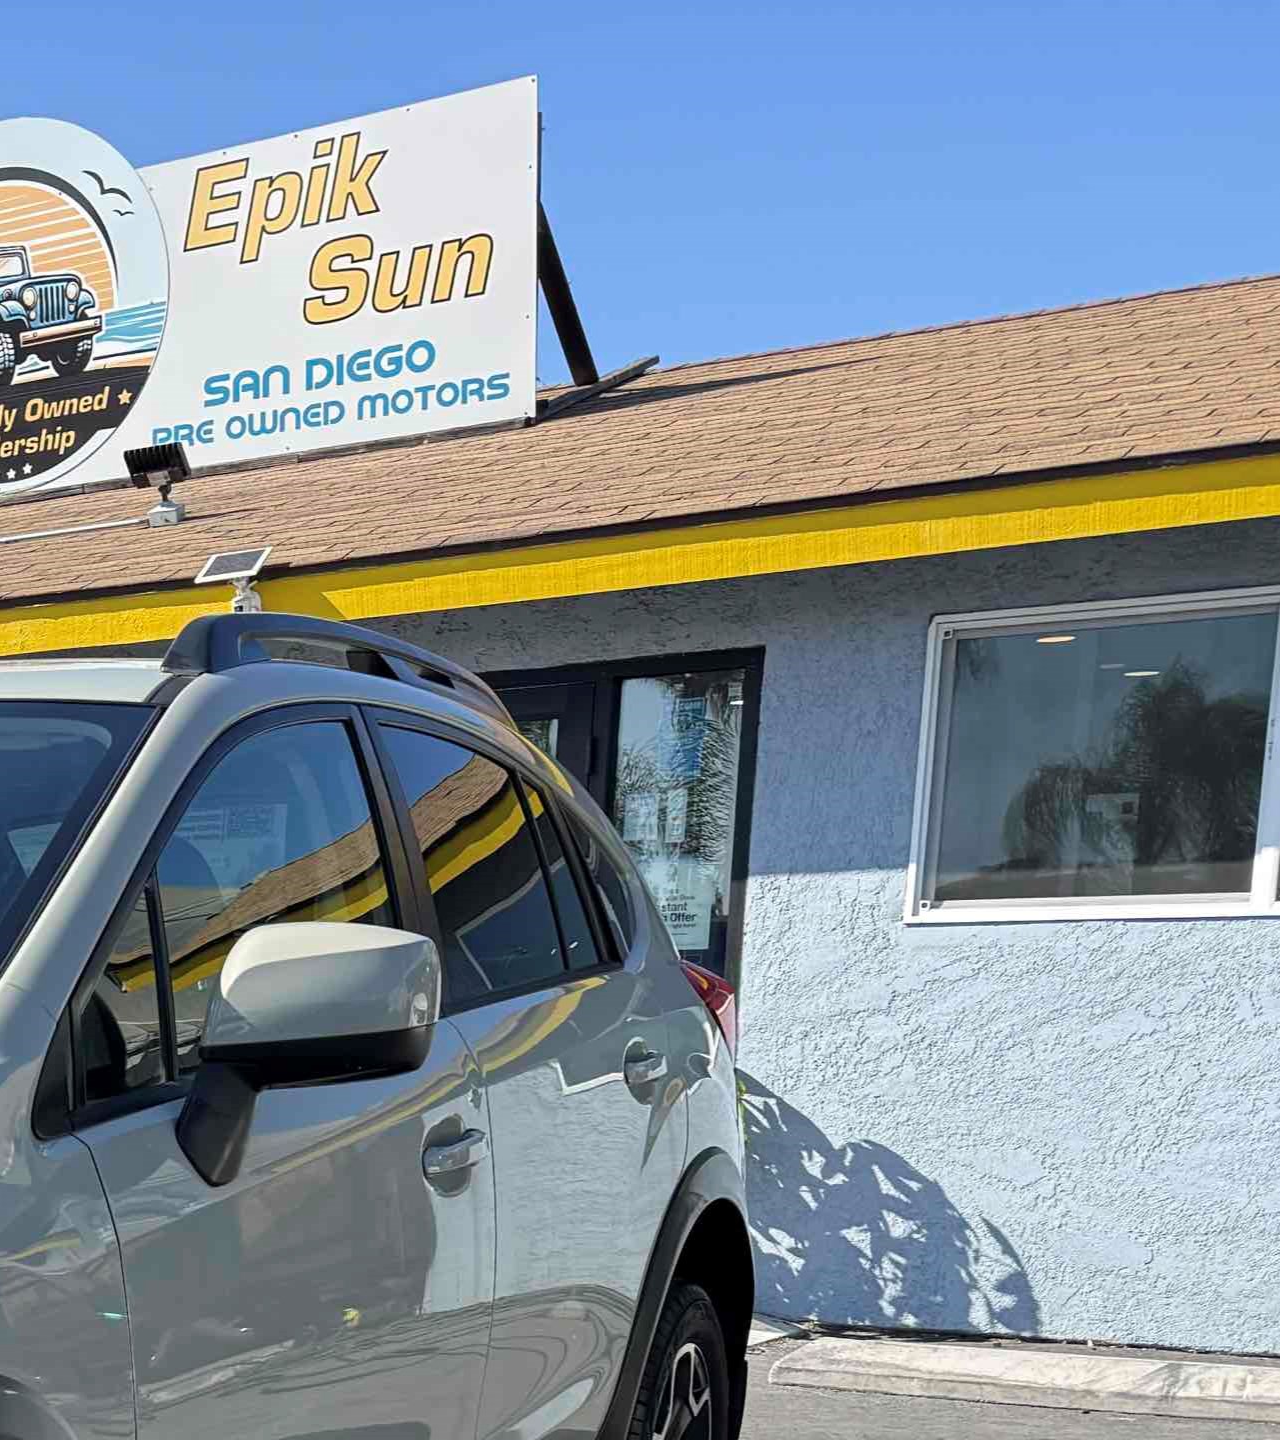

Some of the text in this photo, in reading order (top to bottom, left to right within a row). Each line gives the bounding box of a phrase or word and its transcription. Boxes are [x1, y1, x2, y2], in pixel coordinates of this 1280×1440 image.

[184, 131, 388, 265] Epik
[303, 230, 494, 326] Sun
[24, 386, 110, 422] Owned
[152, 373, 510, 447] PRE OWNED MOTORS
[203, 340, 436, 407] SAN DIEGO
